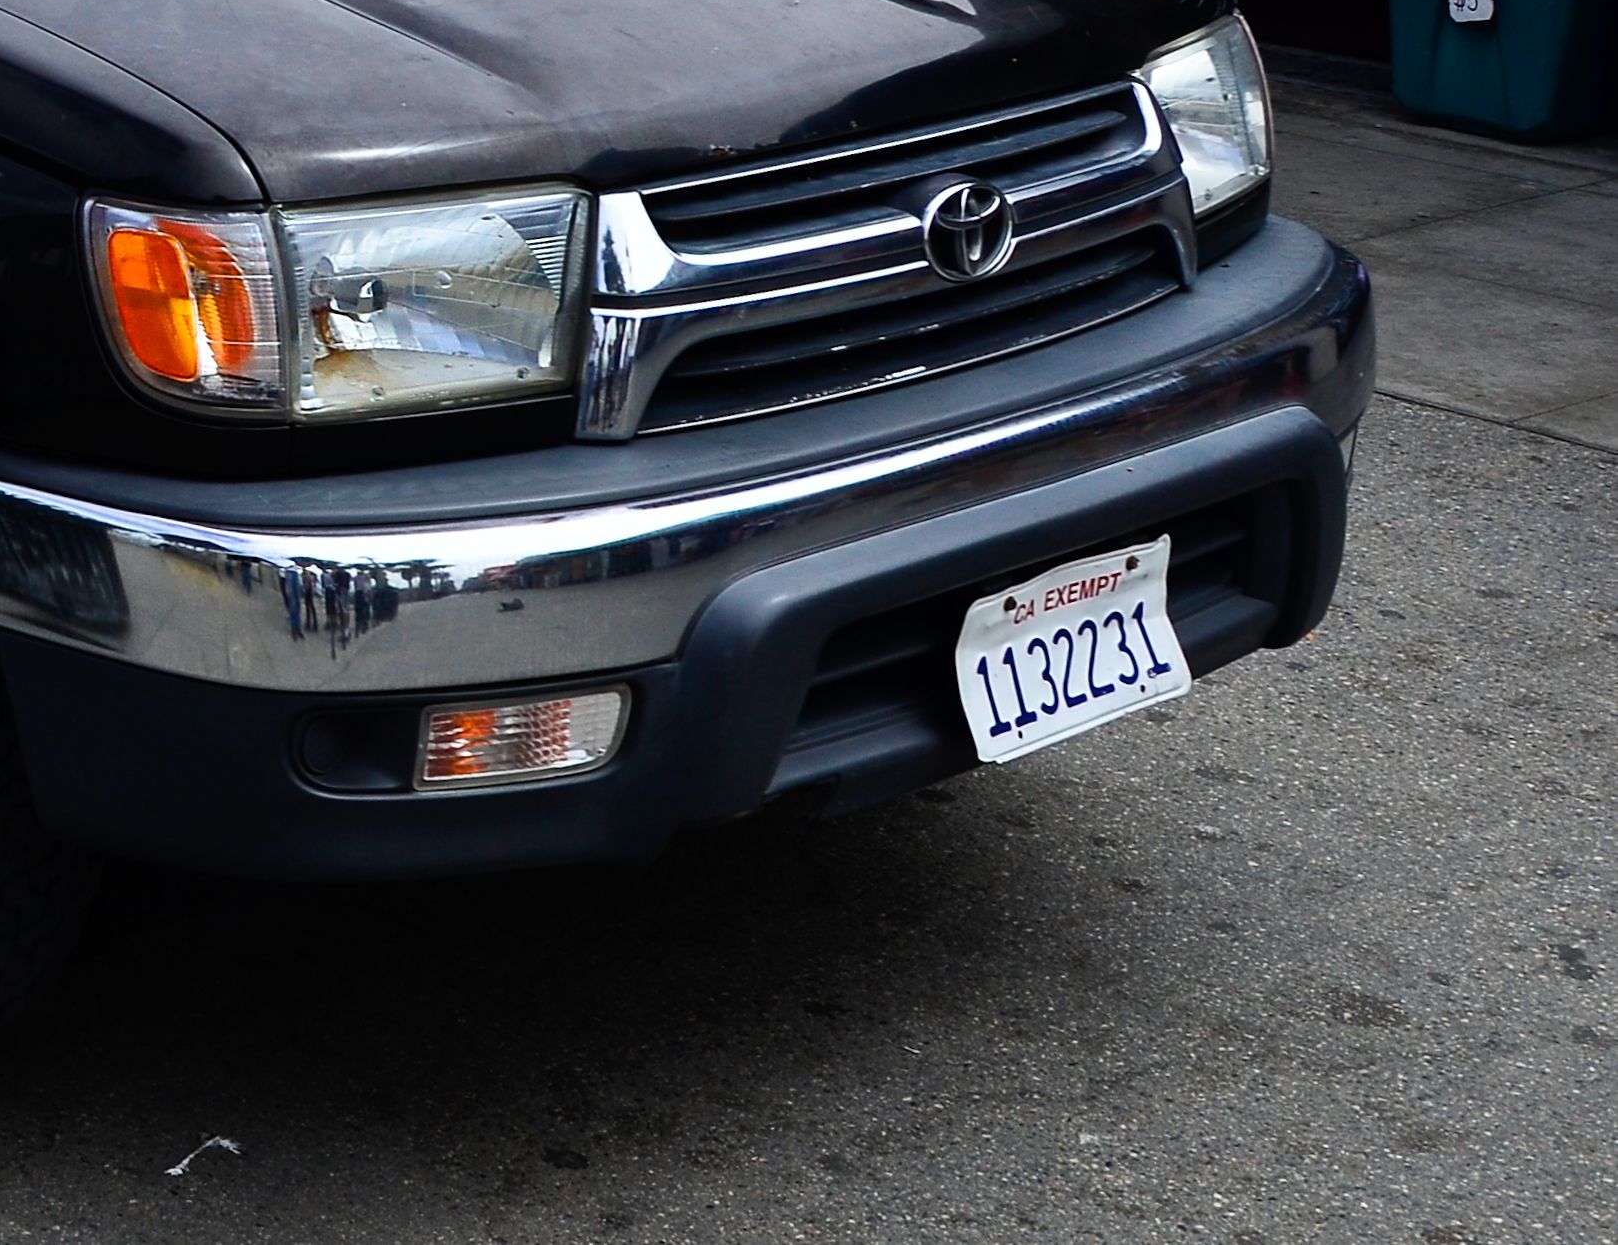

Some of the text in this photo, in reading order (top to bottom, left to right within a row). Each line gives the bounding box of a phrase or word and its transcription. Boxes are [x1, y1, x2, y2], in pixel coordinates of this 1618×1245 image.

[1012, 571, 1123, 625] CA EXEMPT
[976, 601, 1172, 738] 1132231
